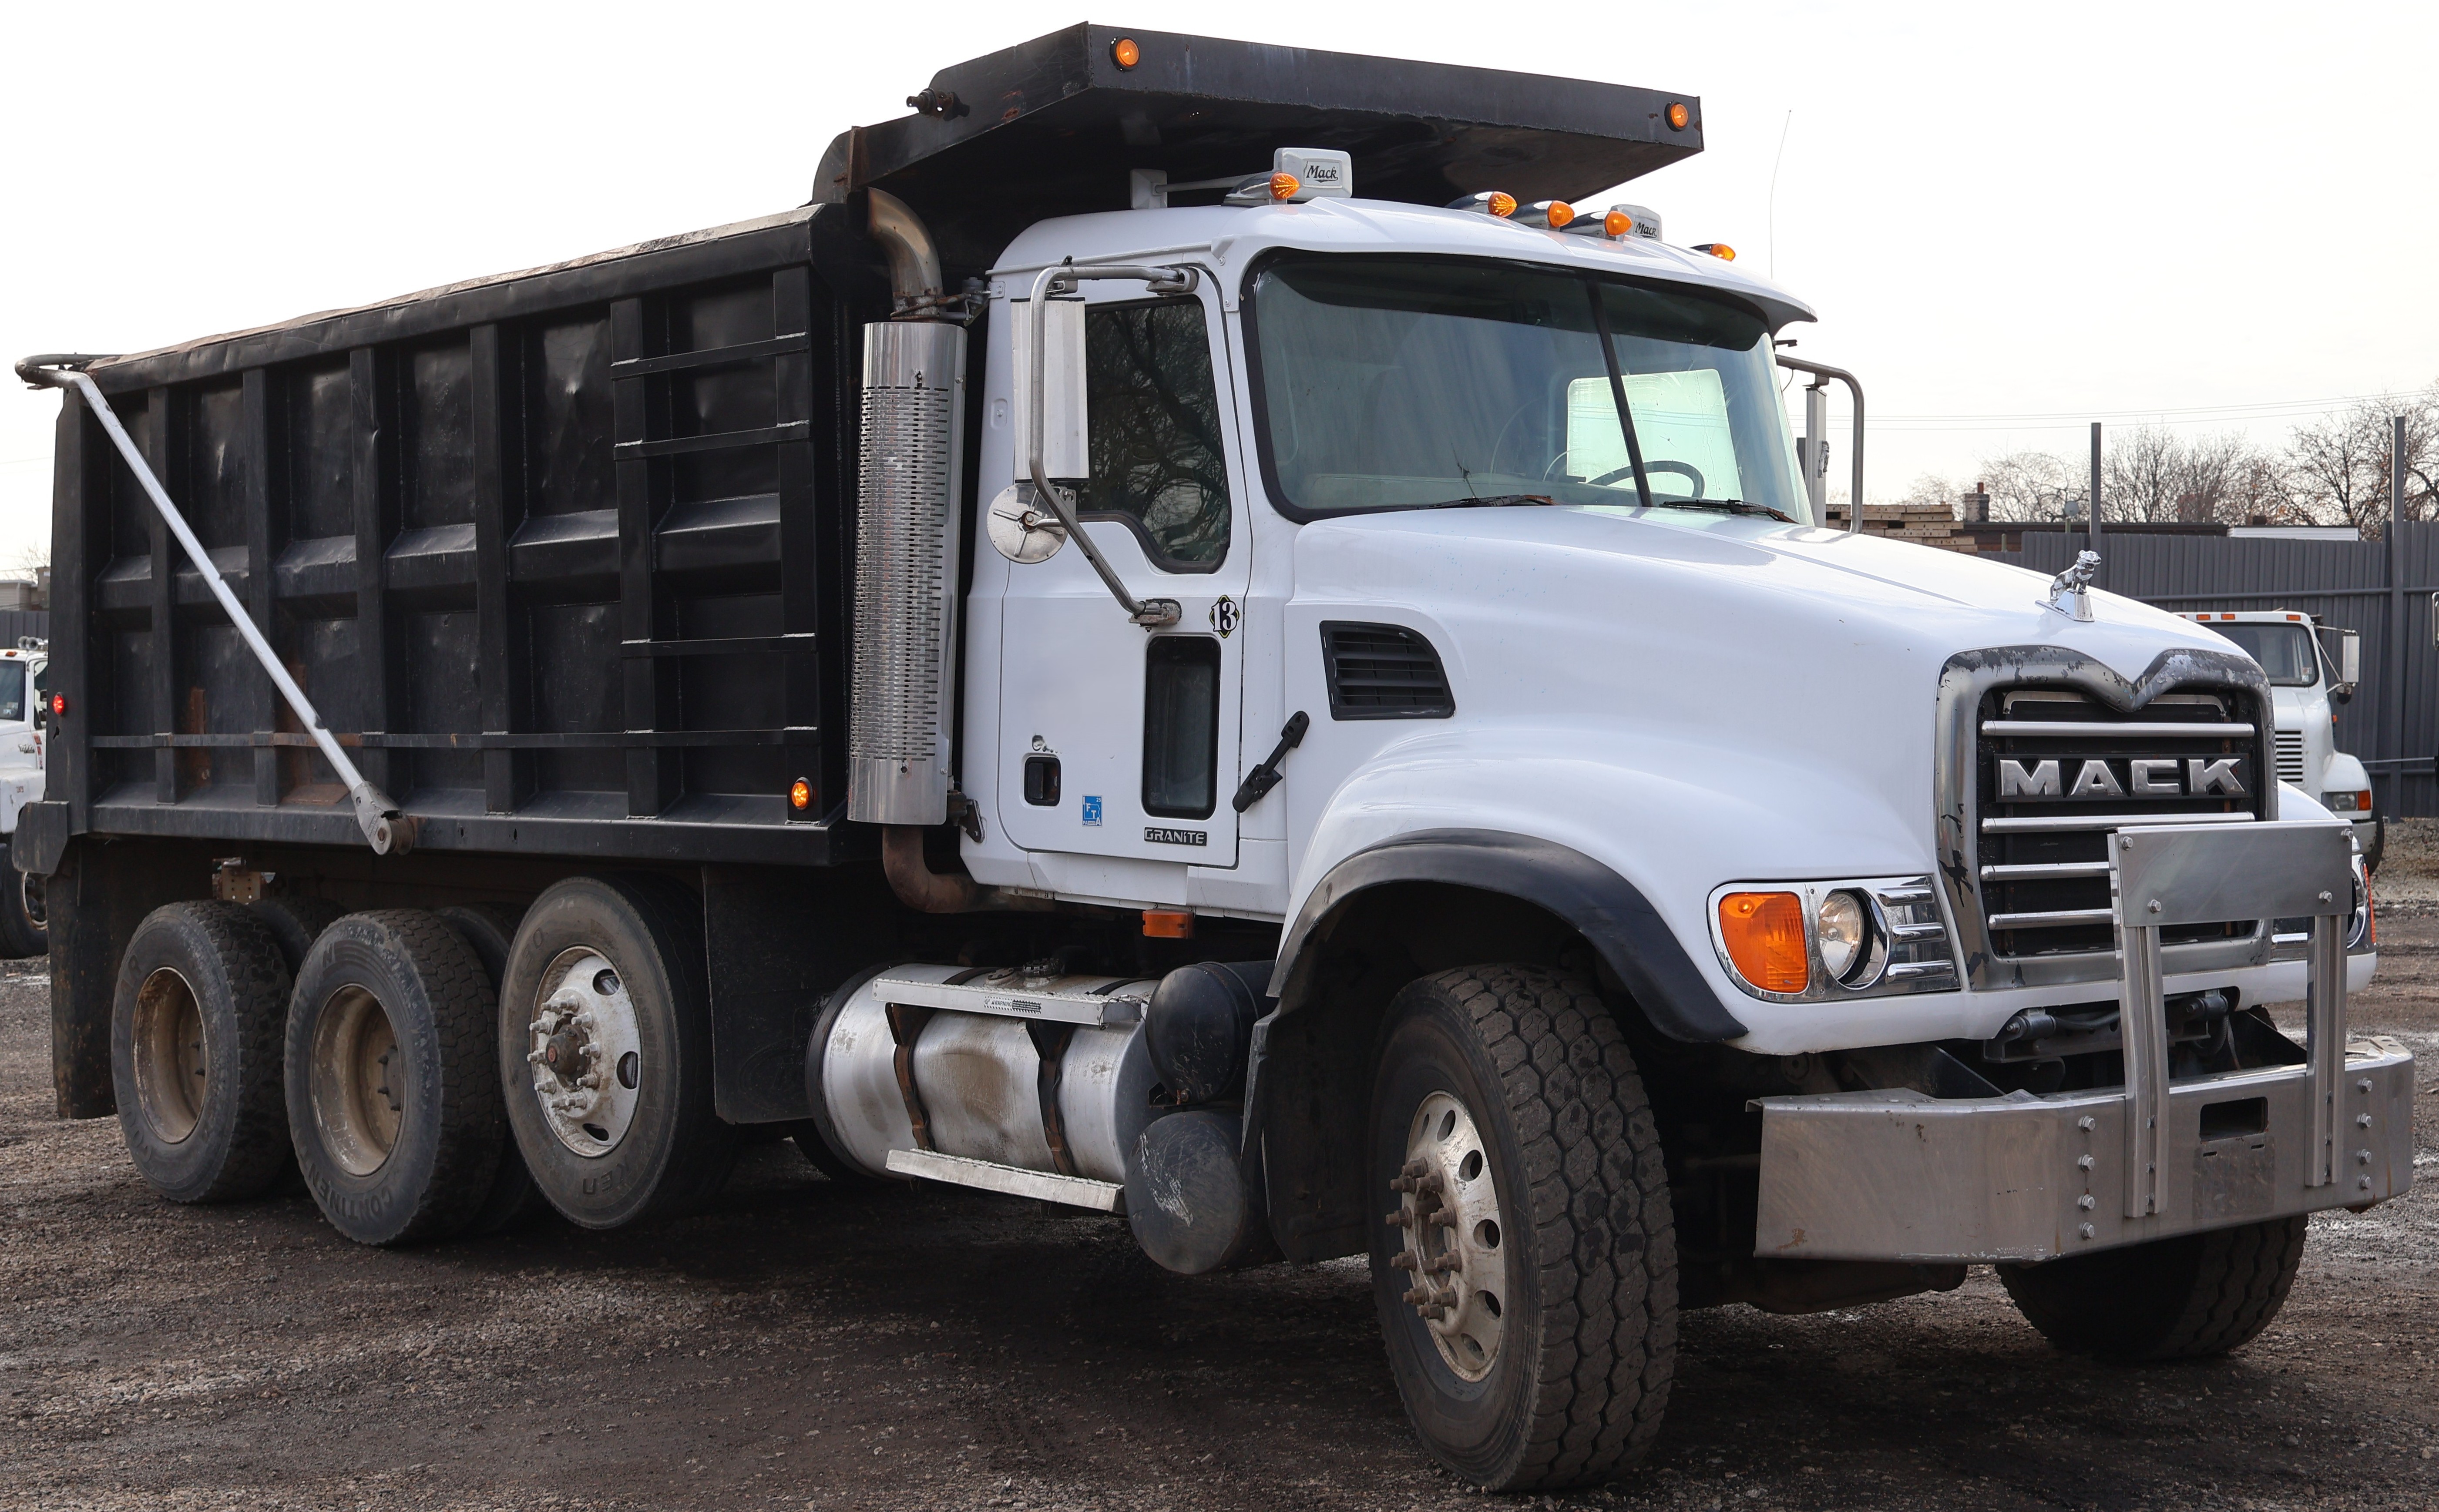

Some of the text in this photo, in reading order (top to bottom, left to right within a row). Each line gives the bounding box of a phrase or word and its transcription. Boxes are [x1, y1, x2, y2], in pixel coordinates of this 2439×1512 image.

[1306, 165, 1338, 183] Mack
[1635, 222, 1657, 238] Mack
[1212, 601, 1237, 632] 13
[2000, 758, 2246, 797] MACK
[1145, 828, 1204, 844] GRANITE
